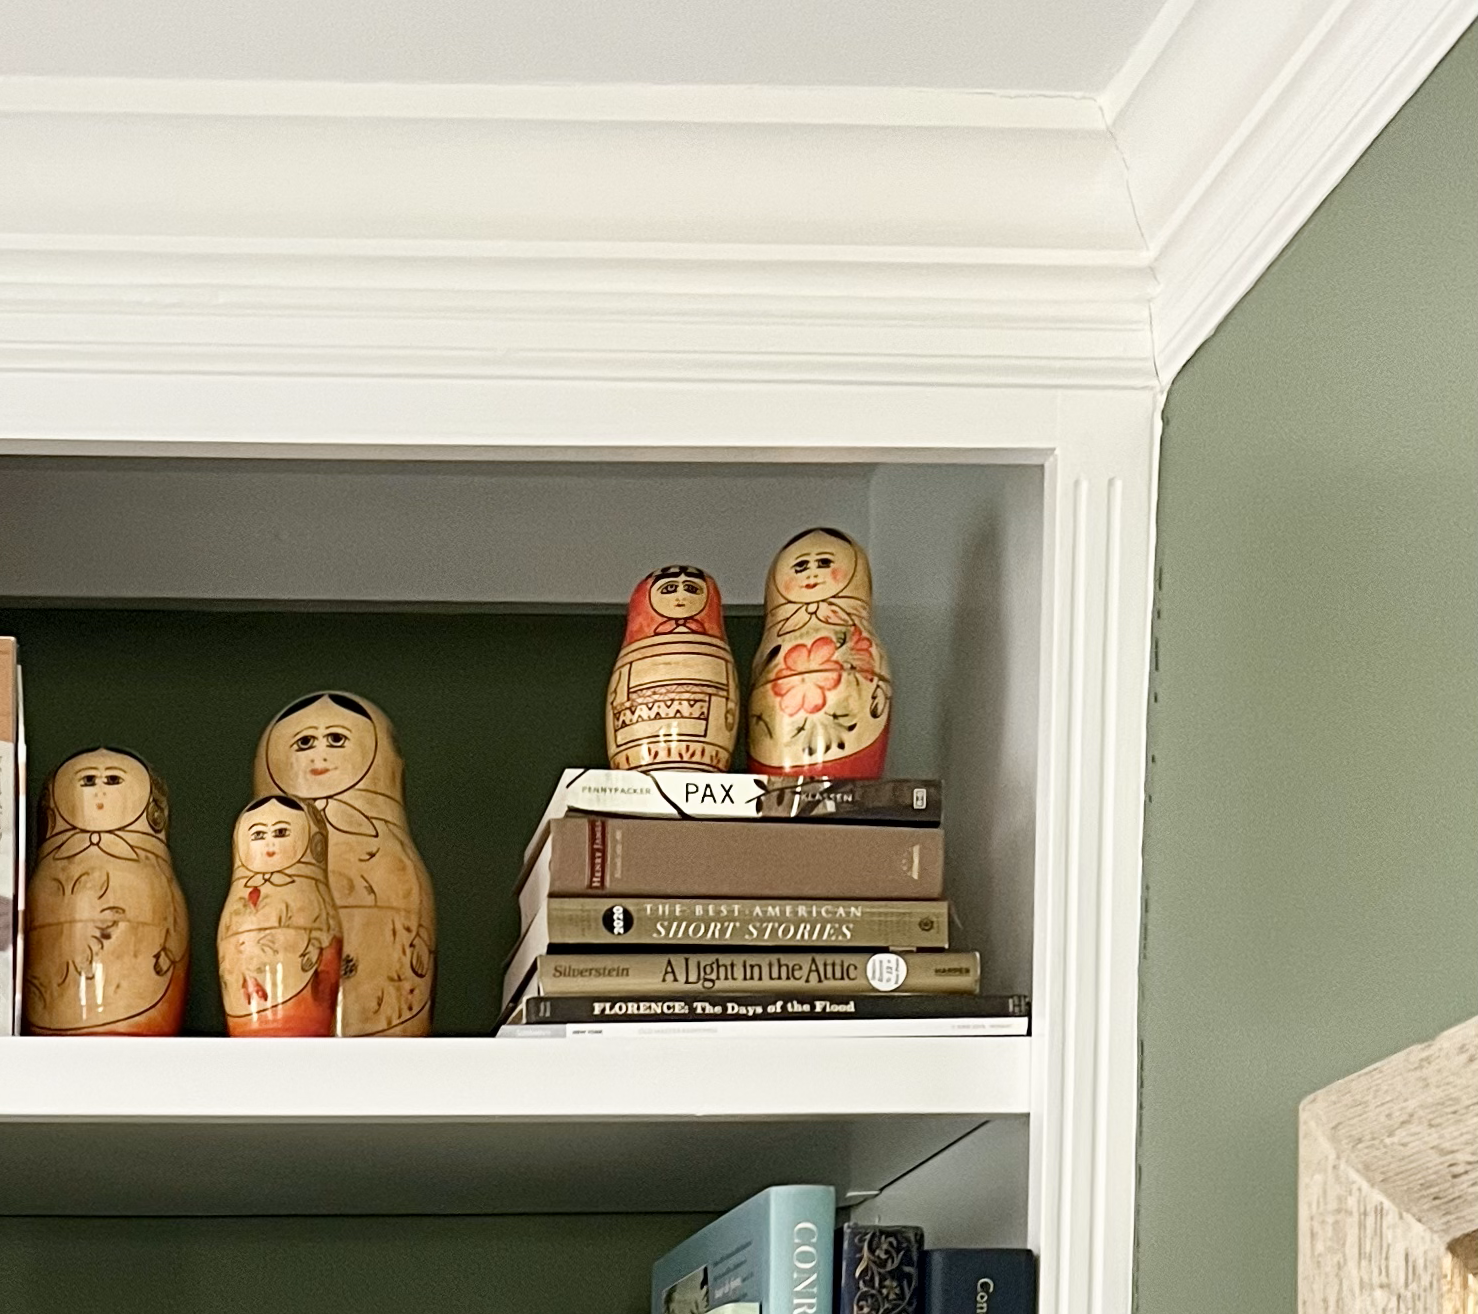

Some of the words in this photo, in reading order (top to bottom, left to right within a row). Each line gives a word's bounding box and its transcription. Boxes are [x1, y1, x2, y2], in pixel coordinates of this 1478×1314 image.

[684, 783, 735, 804] PAX
[644, 903, 681, 917] THE
[695, 904, 741, 917] BEST
[754, 904, 863, 917] AMERICAN
[612, 906, 624, 936] 2020
[653, 921, 738, 939] SHORT
[746, 922, 854, 940] STORIES
[661, 959, 678, 981] A
[683, 957, 737, 989] Light
[743, 959, 764, 981] in
[768, 959, 802, 981] the
[805, 959, 858, 982] Attic
[694, 1001, 722, 1015] The
[727, 1001, 762, 1016] Days
[767, 1001, 782, 1014] of
[786, 1001, 810, 1014] the
[815, 1000, 854, 1013] Flood
